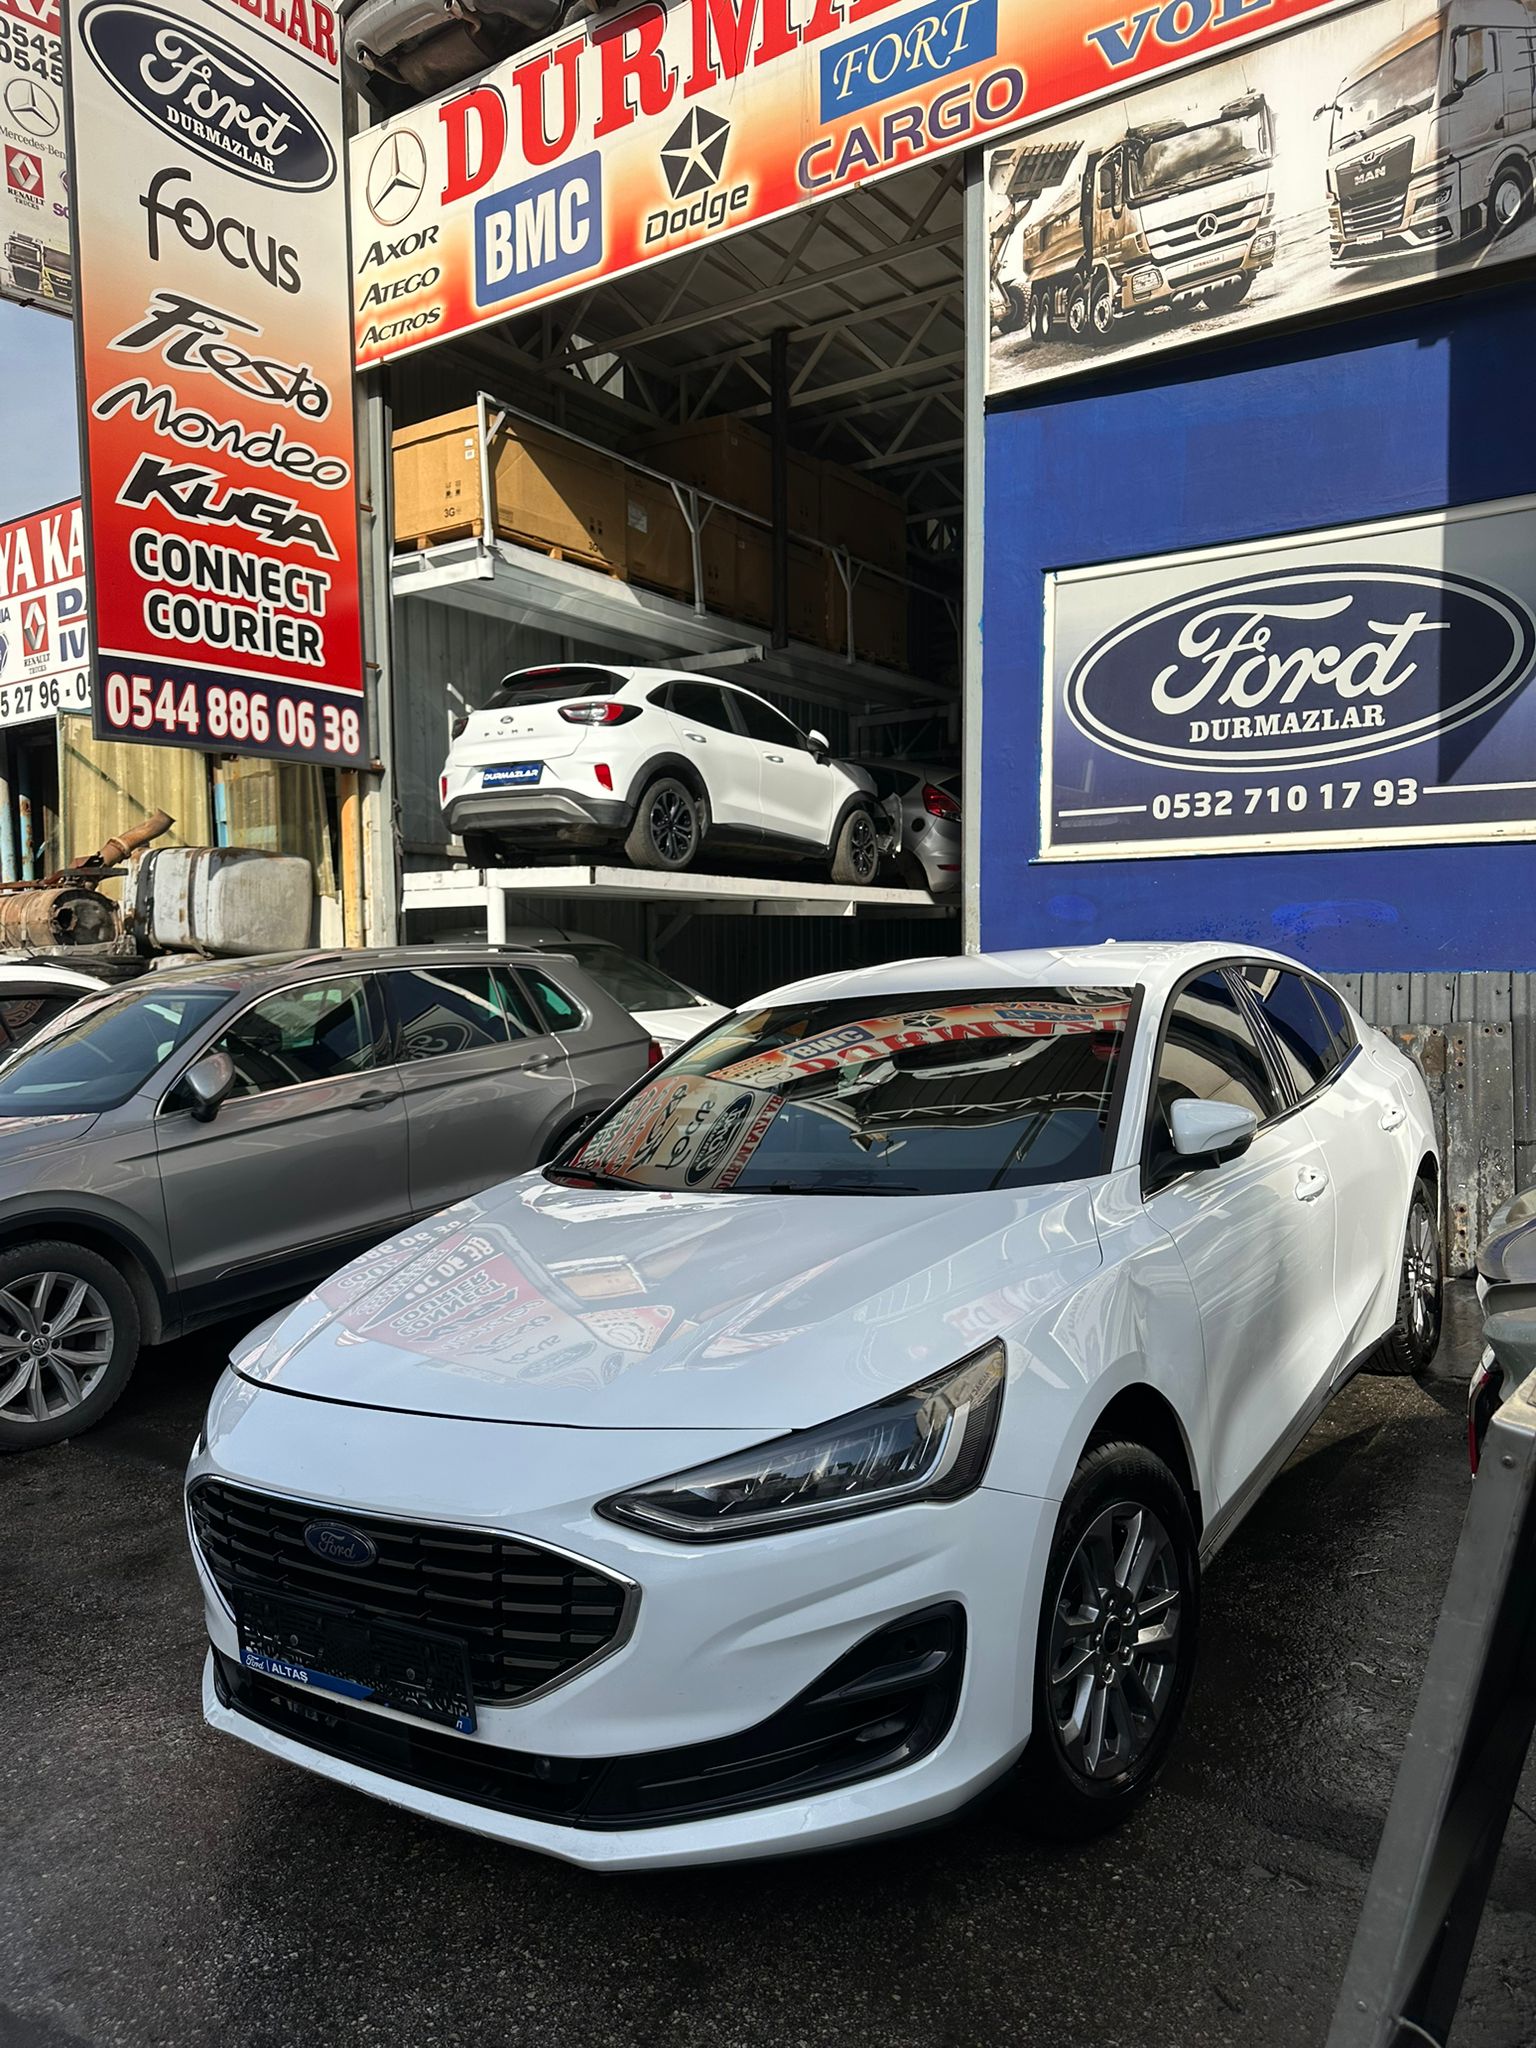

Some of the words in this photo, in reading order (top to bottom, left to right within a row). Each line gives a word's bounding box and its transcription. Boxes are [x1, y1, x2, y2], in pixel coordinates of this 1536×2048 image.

[833, 0, 980, 101] FORT
[166, 104, 275, 175] DURMAZLAR
[799, 68, 1024, 190] CARGO
[8, 188, 45, 206] RENAULT
[1354, 166, 1386, 186] MAN
[485, 178, 590, 287] BMC
[645, 184, 749, 244] Dodge
[358, 224, 440, 274] AXOR
[359, 267, 441, 312] ATEGO
[359, 307, 442, 349] ACTROS
[96, 382, 347, 485] Mondeo
[133, 532, 328, 614] CONNECT
[15, 685, 33, 714] 27
[39, 678, 60, 709] 96
[106, 671, 200, 735] 0544
[206, 685, 270, 745] 886
[277, 696, 317, 751] 06
[322, 704, 361, 756] 38
[1189, 704, 1386, 743] DURMAZLAR
[483, 769, 539, 781] DURMAZLAR
[1152, 790, 1233, 820] 0532
[1244, 785, 1307, 815] 710
[1319, 782, 1362, 810] 17
[1373, 777, 1419, 807] 93
[319, 1531, 356, 1559] Ford
[246, 1655, 264, 1670] Ford
[272, 1663, 308, 1683] ALTAŞ
